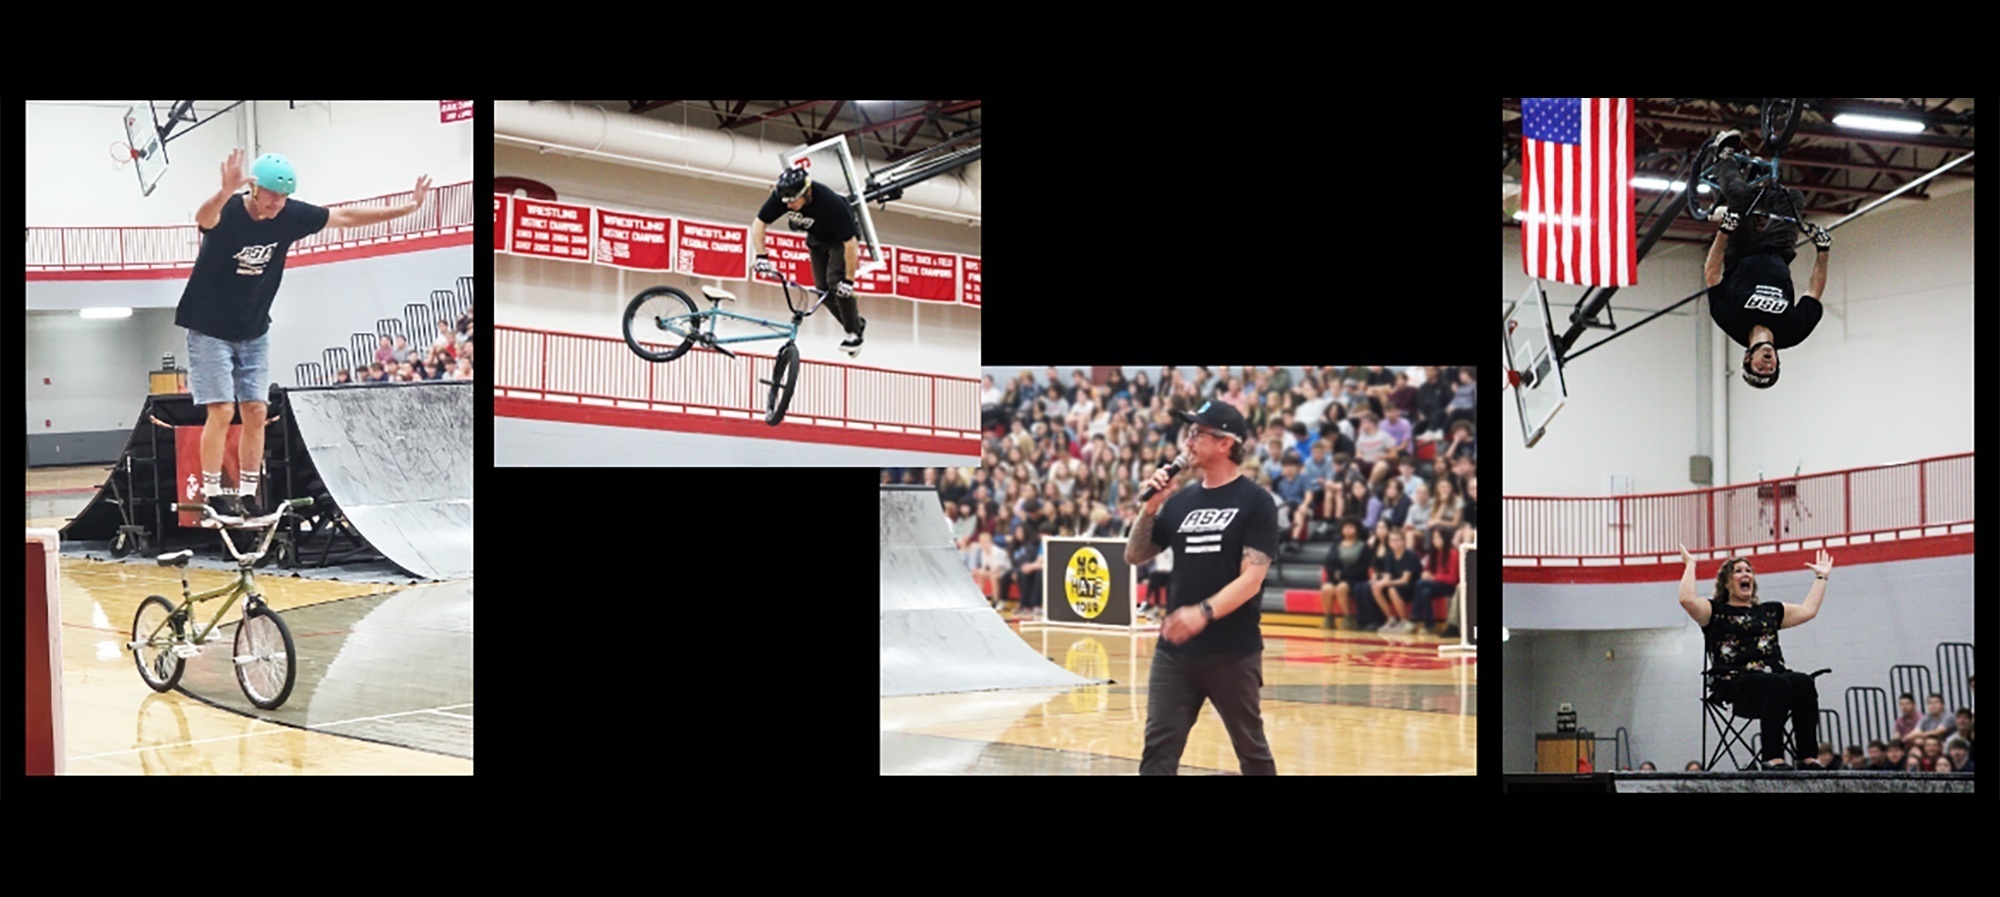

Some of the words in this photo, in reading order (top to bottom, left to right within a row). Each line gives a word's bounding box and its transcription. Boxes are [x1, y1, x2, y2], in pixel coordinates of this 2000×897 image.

[526, 204, 577, 220] WRESTLING
[549, 220, 584, 234] CHAMPIONS
[604, 214, 665, 232] WRESTLING
[631, 231, 665, 244] CHAMPIONS
[684, 225, 742, 242] WRESTLING
[711, 241, 744, 254] CHAMPIONS
[920, 266, 953, 279] CHAMPIONS
[1746, 297, 1787, 312] ASA
[1181, 509, 1236, 528] ASA
[1076, 556, 1098, 576] NO
[1071, 576, 1104, 598] HATE
[1076, 601, 1099, 613] TOUR
